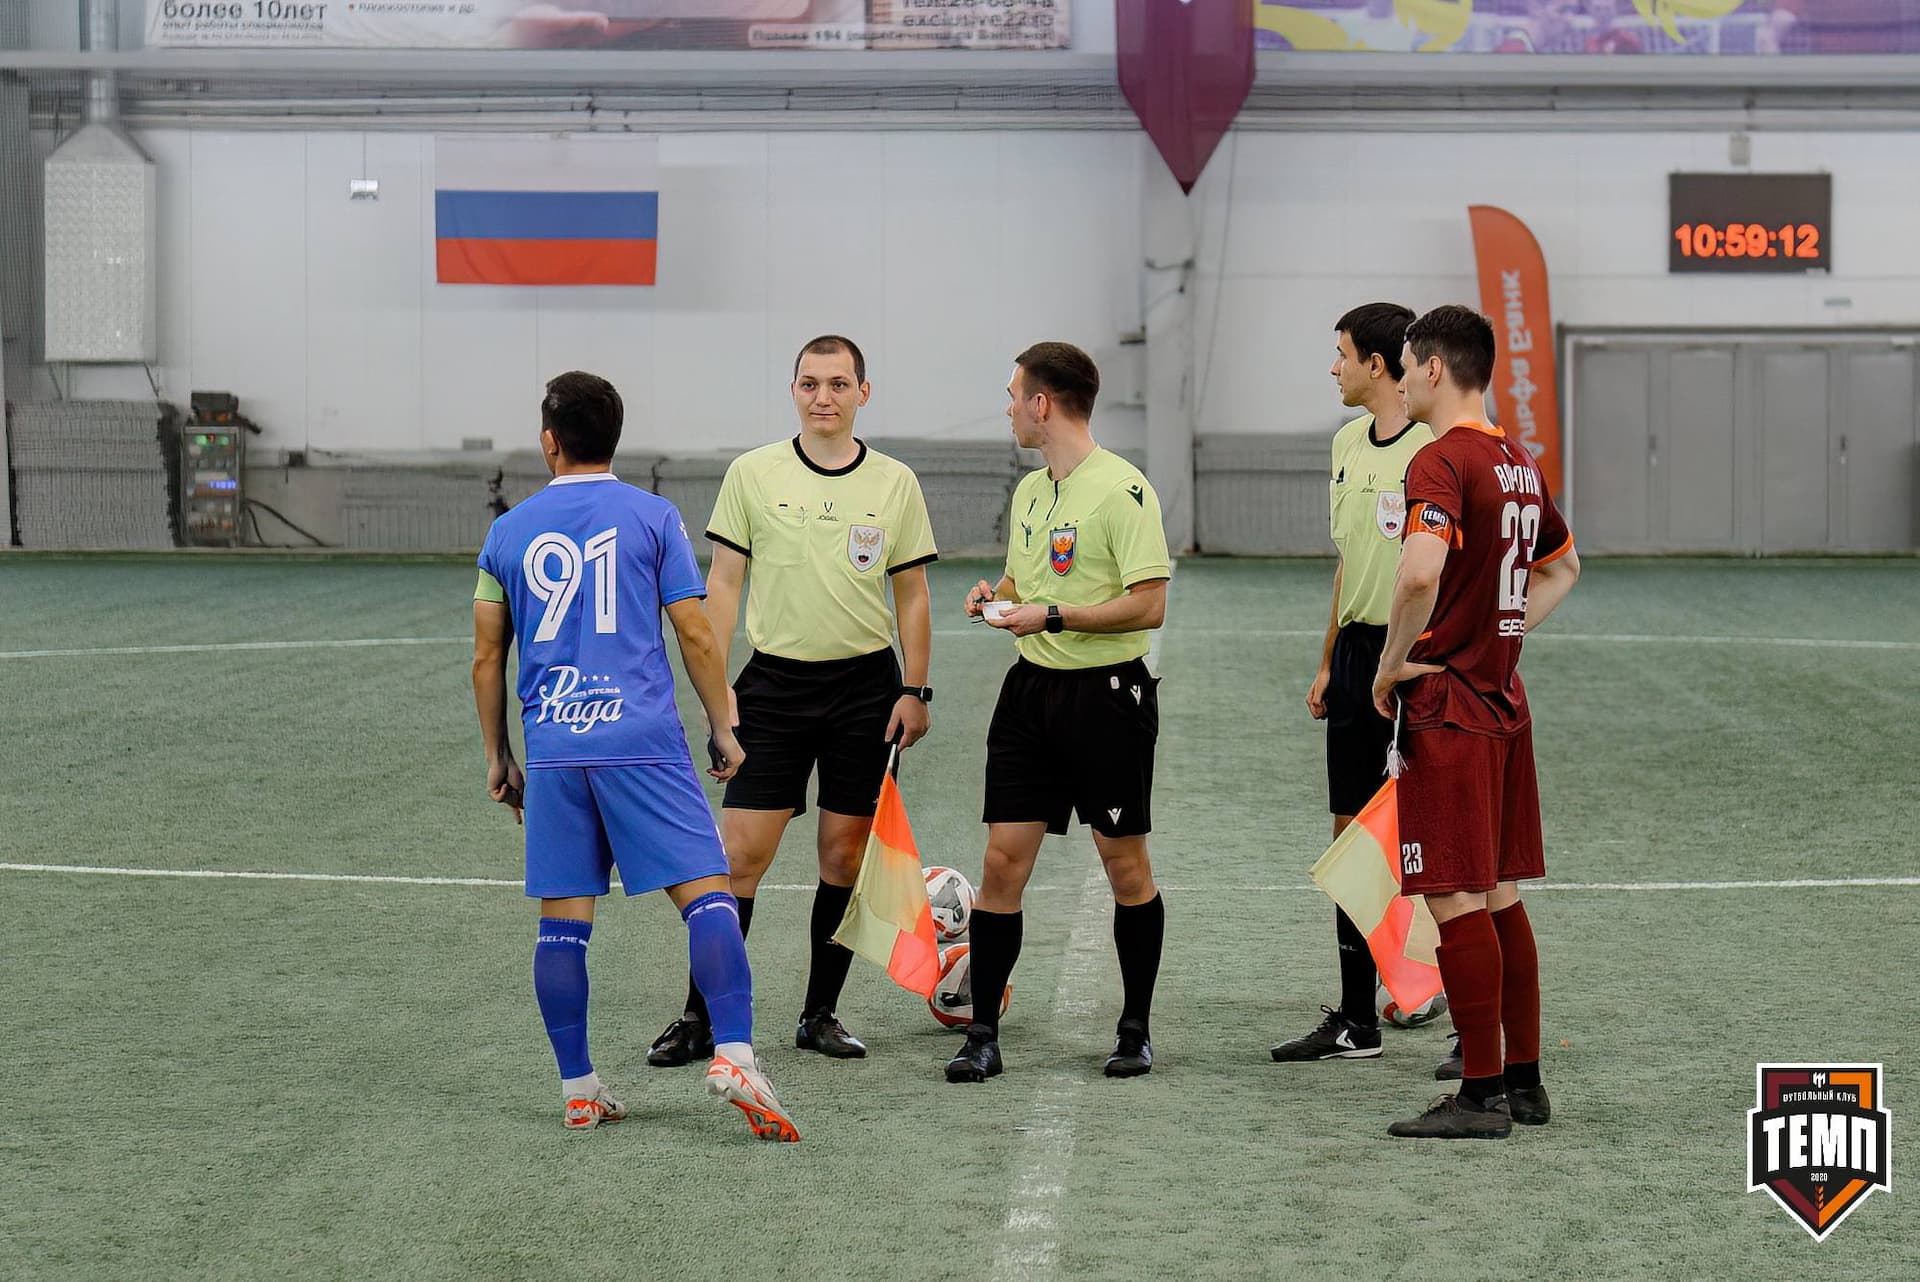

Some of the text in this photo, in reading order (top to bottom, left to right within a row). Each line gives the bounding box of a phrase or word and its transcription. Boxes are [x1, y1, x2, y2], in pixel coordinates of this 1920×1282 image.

[164, 0, 327, 20] более 10лет
[1675, 223, 1819, 258] 10:59:12
[523, 527, 618, 643] 91
[536, 665, 624, 734] Praga
[1402, 842, 1424, 875] 23
